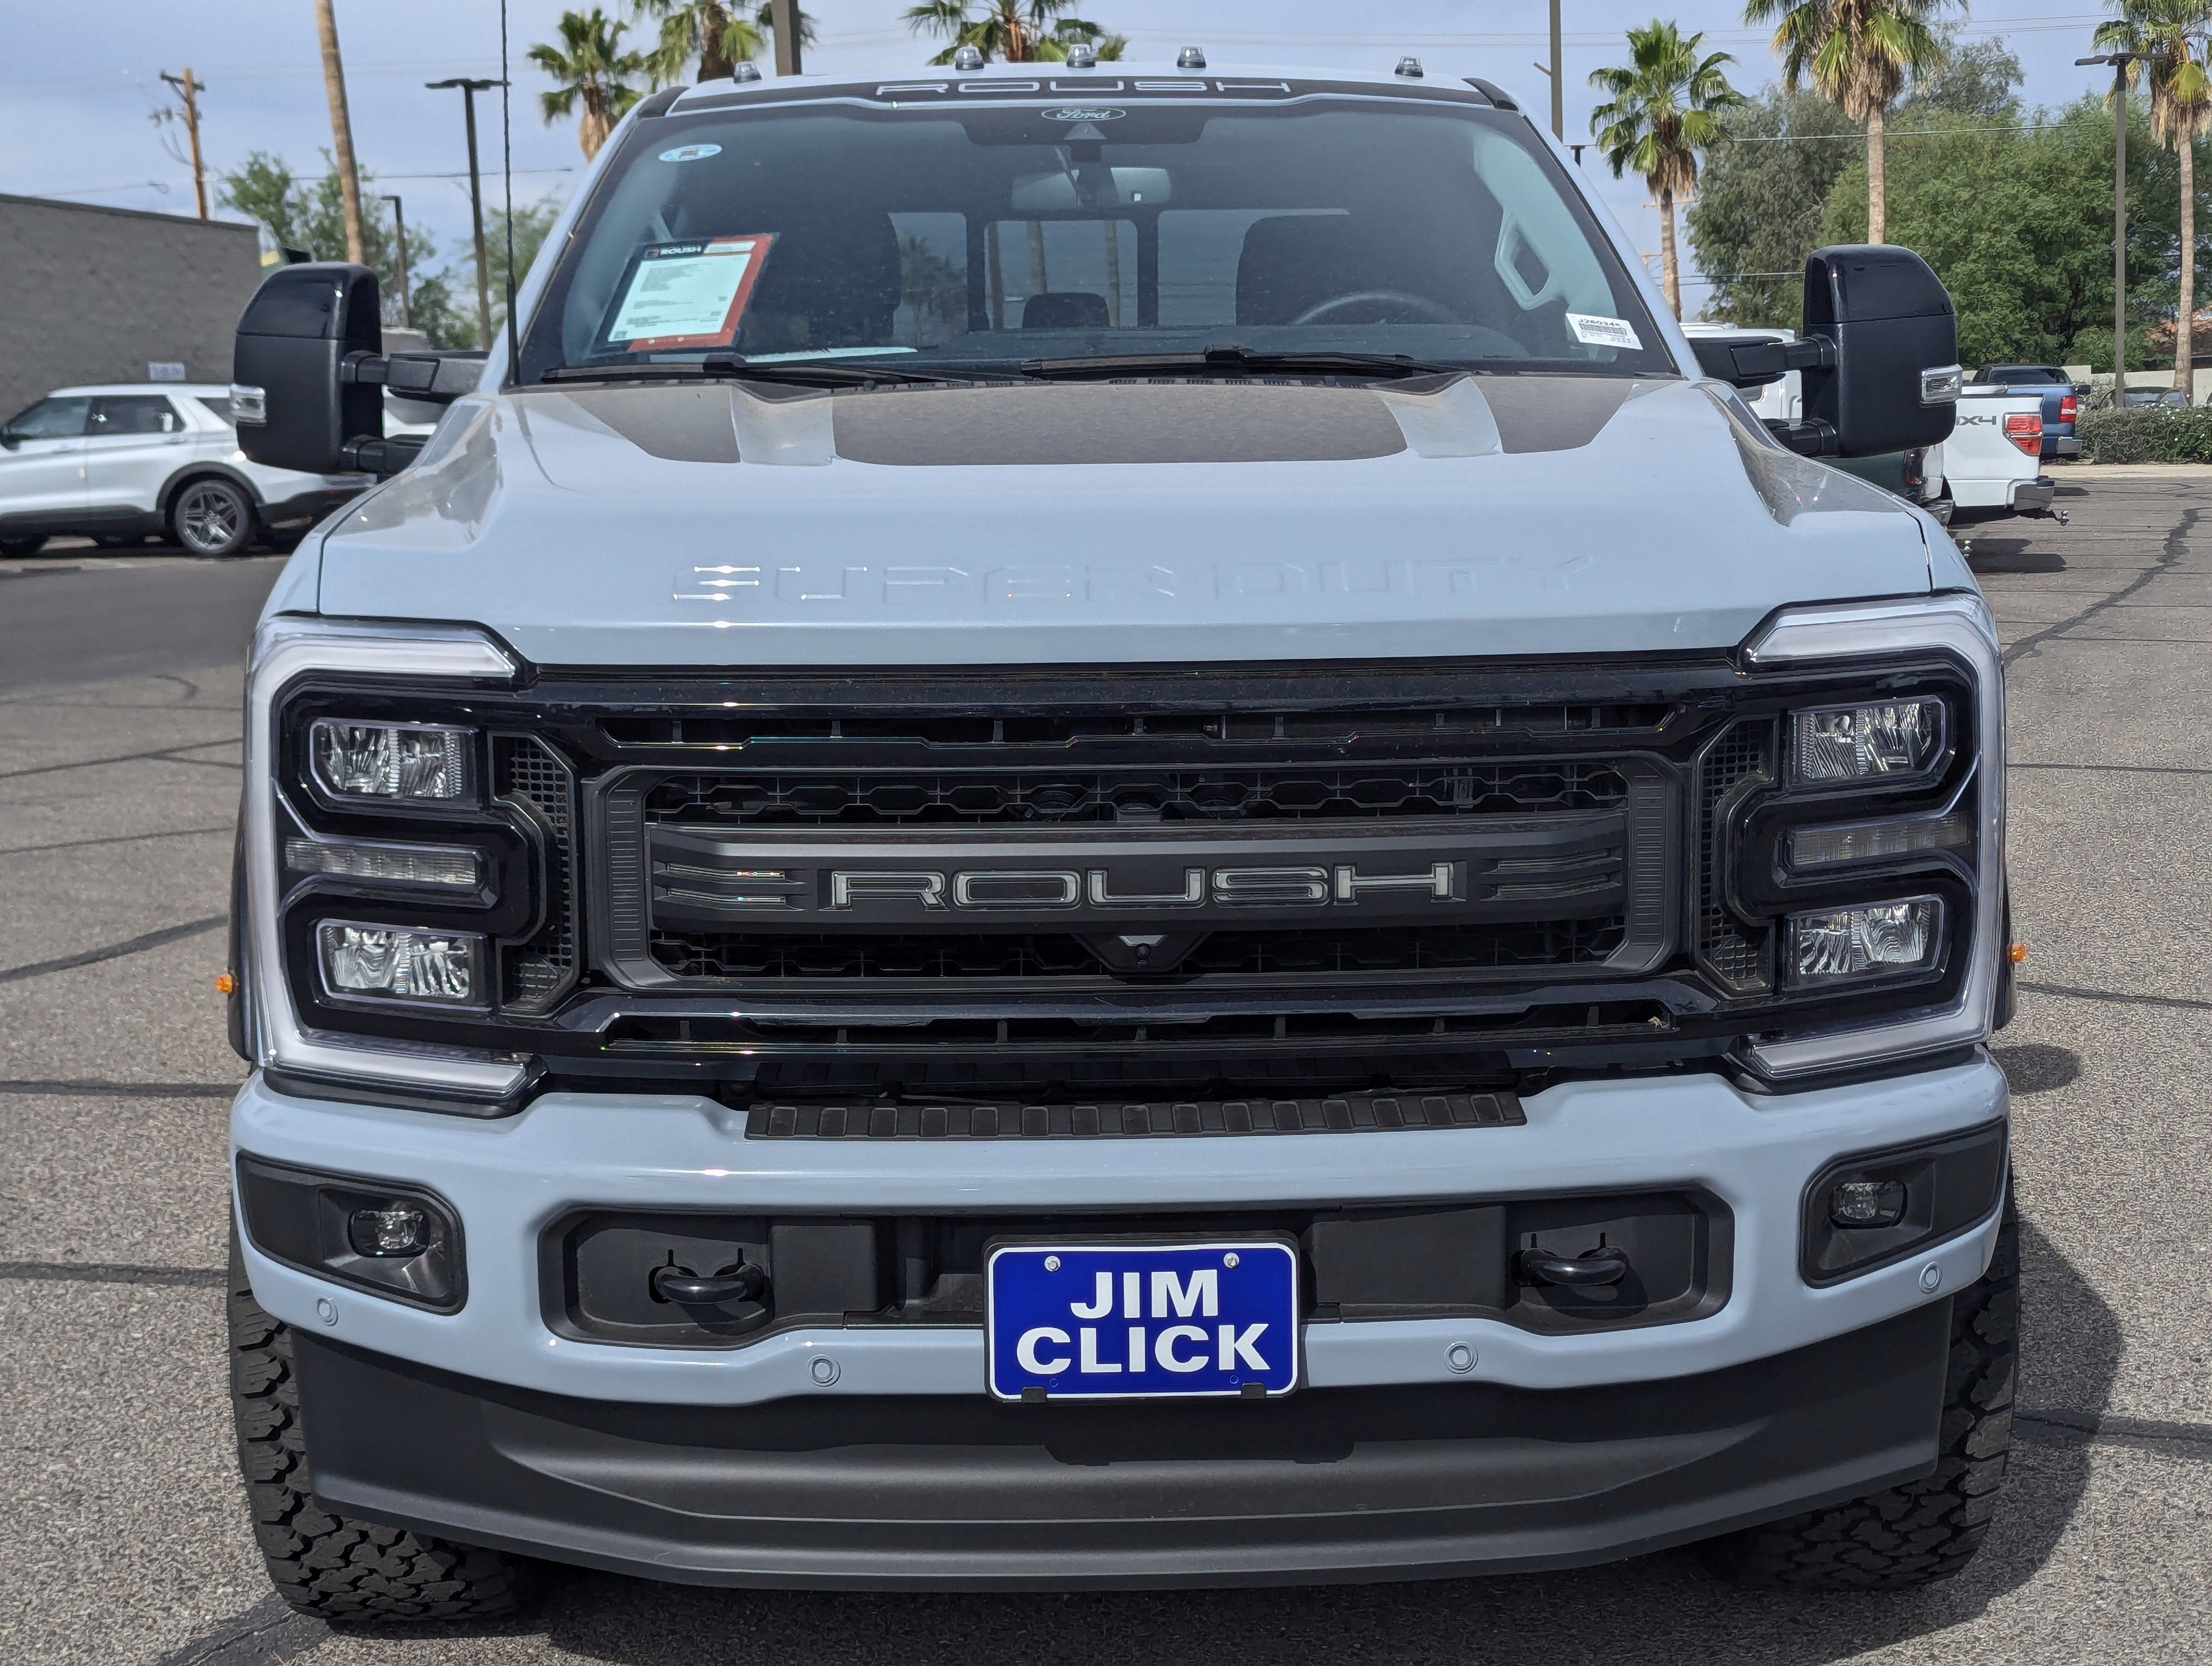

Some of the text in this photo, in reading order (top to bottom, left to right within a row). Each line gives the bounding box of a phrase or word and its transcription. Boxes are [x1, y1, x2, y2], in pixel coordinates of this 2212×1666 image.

[876, 80, 1291, 95] ROUSH
[1056, 107, 1111, 119] Ford
[660, 245, 702, 255] ROUSH
[672, 556, 1595, 605] SUPER DUTY
[818, 861, 1467, 913] ROUSH
[1070, 1269, 1219, 1319] JIM
[1017, 1323, 1271, 1375] CLICK
